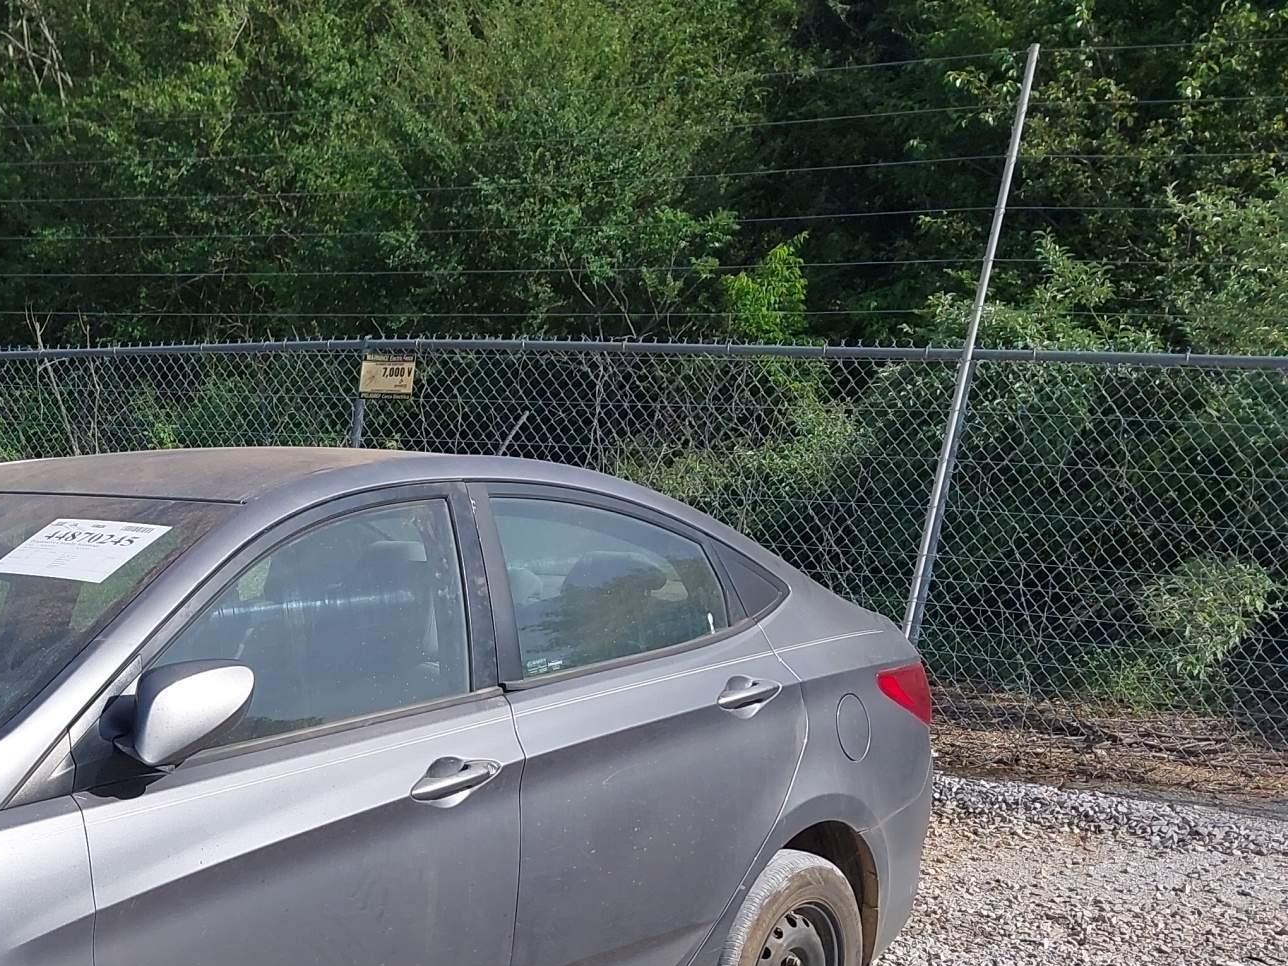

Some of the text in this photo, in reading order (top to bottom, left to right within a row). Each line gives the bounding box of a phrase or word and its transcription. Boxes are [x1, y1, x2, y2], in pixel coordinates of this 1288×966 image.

[382, 367, 413, 378] 7,000 V
[45, 530, 140, 547] 44870245
